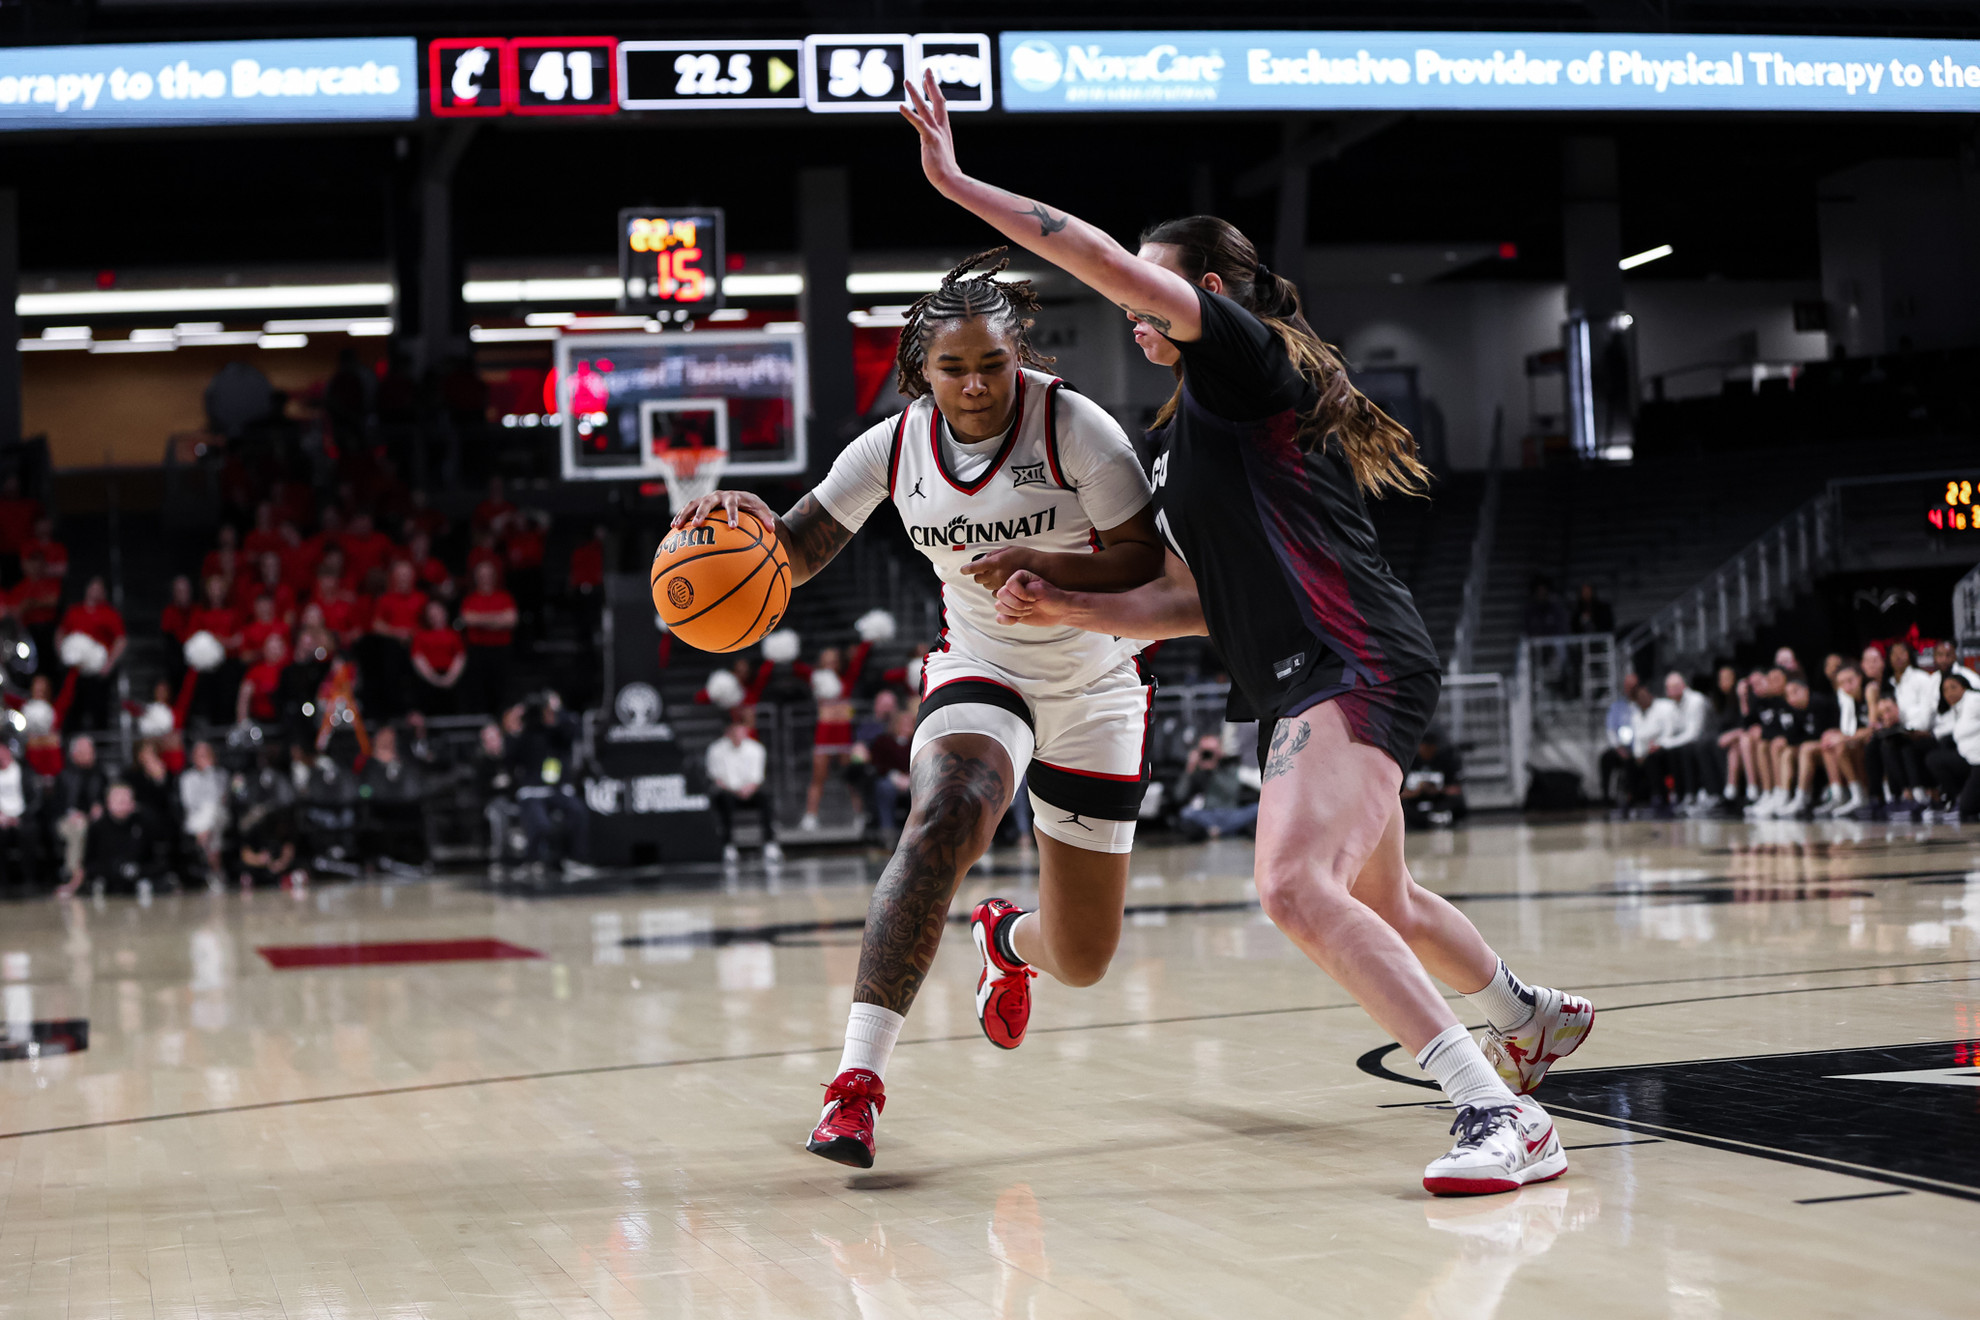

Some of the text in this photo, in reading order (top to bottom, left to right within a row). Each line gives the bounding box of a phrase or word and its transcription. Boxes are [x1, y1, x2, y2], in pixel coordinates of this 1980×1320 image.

[108, 67, 153, 100] to
[157, 61, 226, 100] the
[232, 60, 400, 99] Bearcats
[530, 51, 593, 100] 41
[674, 54, 752, 95] 22.5
[828, 49, 894, 97] 56
[1064, 44, 1225, 83] NovaCare
[1247, 49, 1980, 95] Exclusive Provider of Physical Therapy to the
[657, 248, 706, 302] 15
[909, 506, 1057, 547] CINCINNATI
